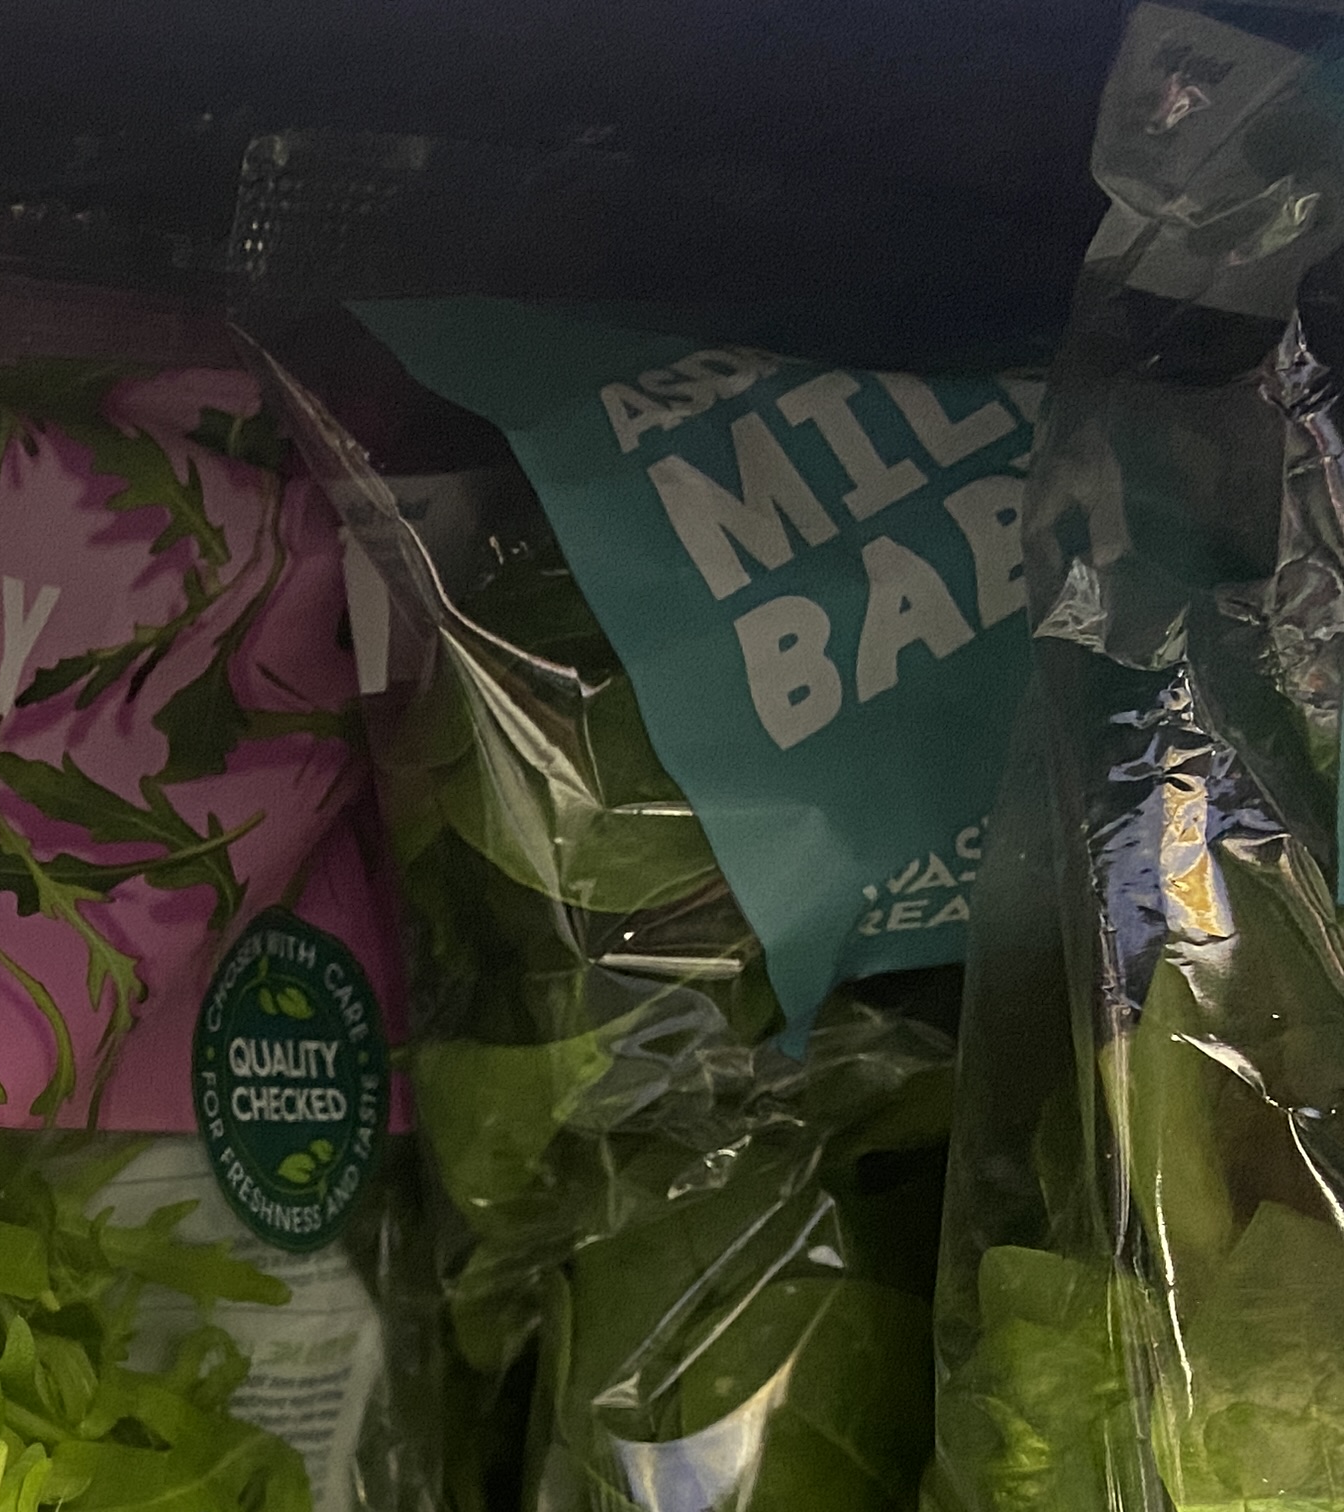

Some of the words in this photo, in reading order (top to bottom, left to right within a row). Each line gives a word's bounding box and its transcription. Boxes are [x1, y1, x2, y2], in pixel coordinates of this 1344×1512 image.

[323, 963, 369, 1042] CARE
[228, 1037, 339, 1079] QUALITY
[231, 1086, 348, 1122] CHECKED
[201, 1071, 225, 1140] FOR
[219, 1147, 323, 1235] FRESHNESS
[325, 1163, 360, 1222] AND
